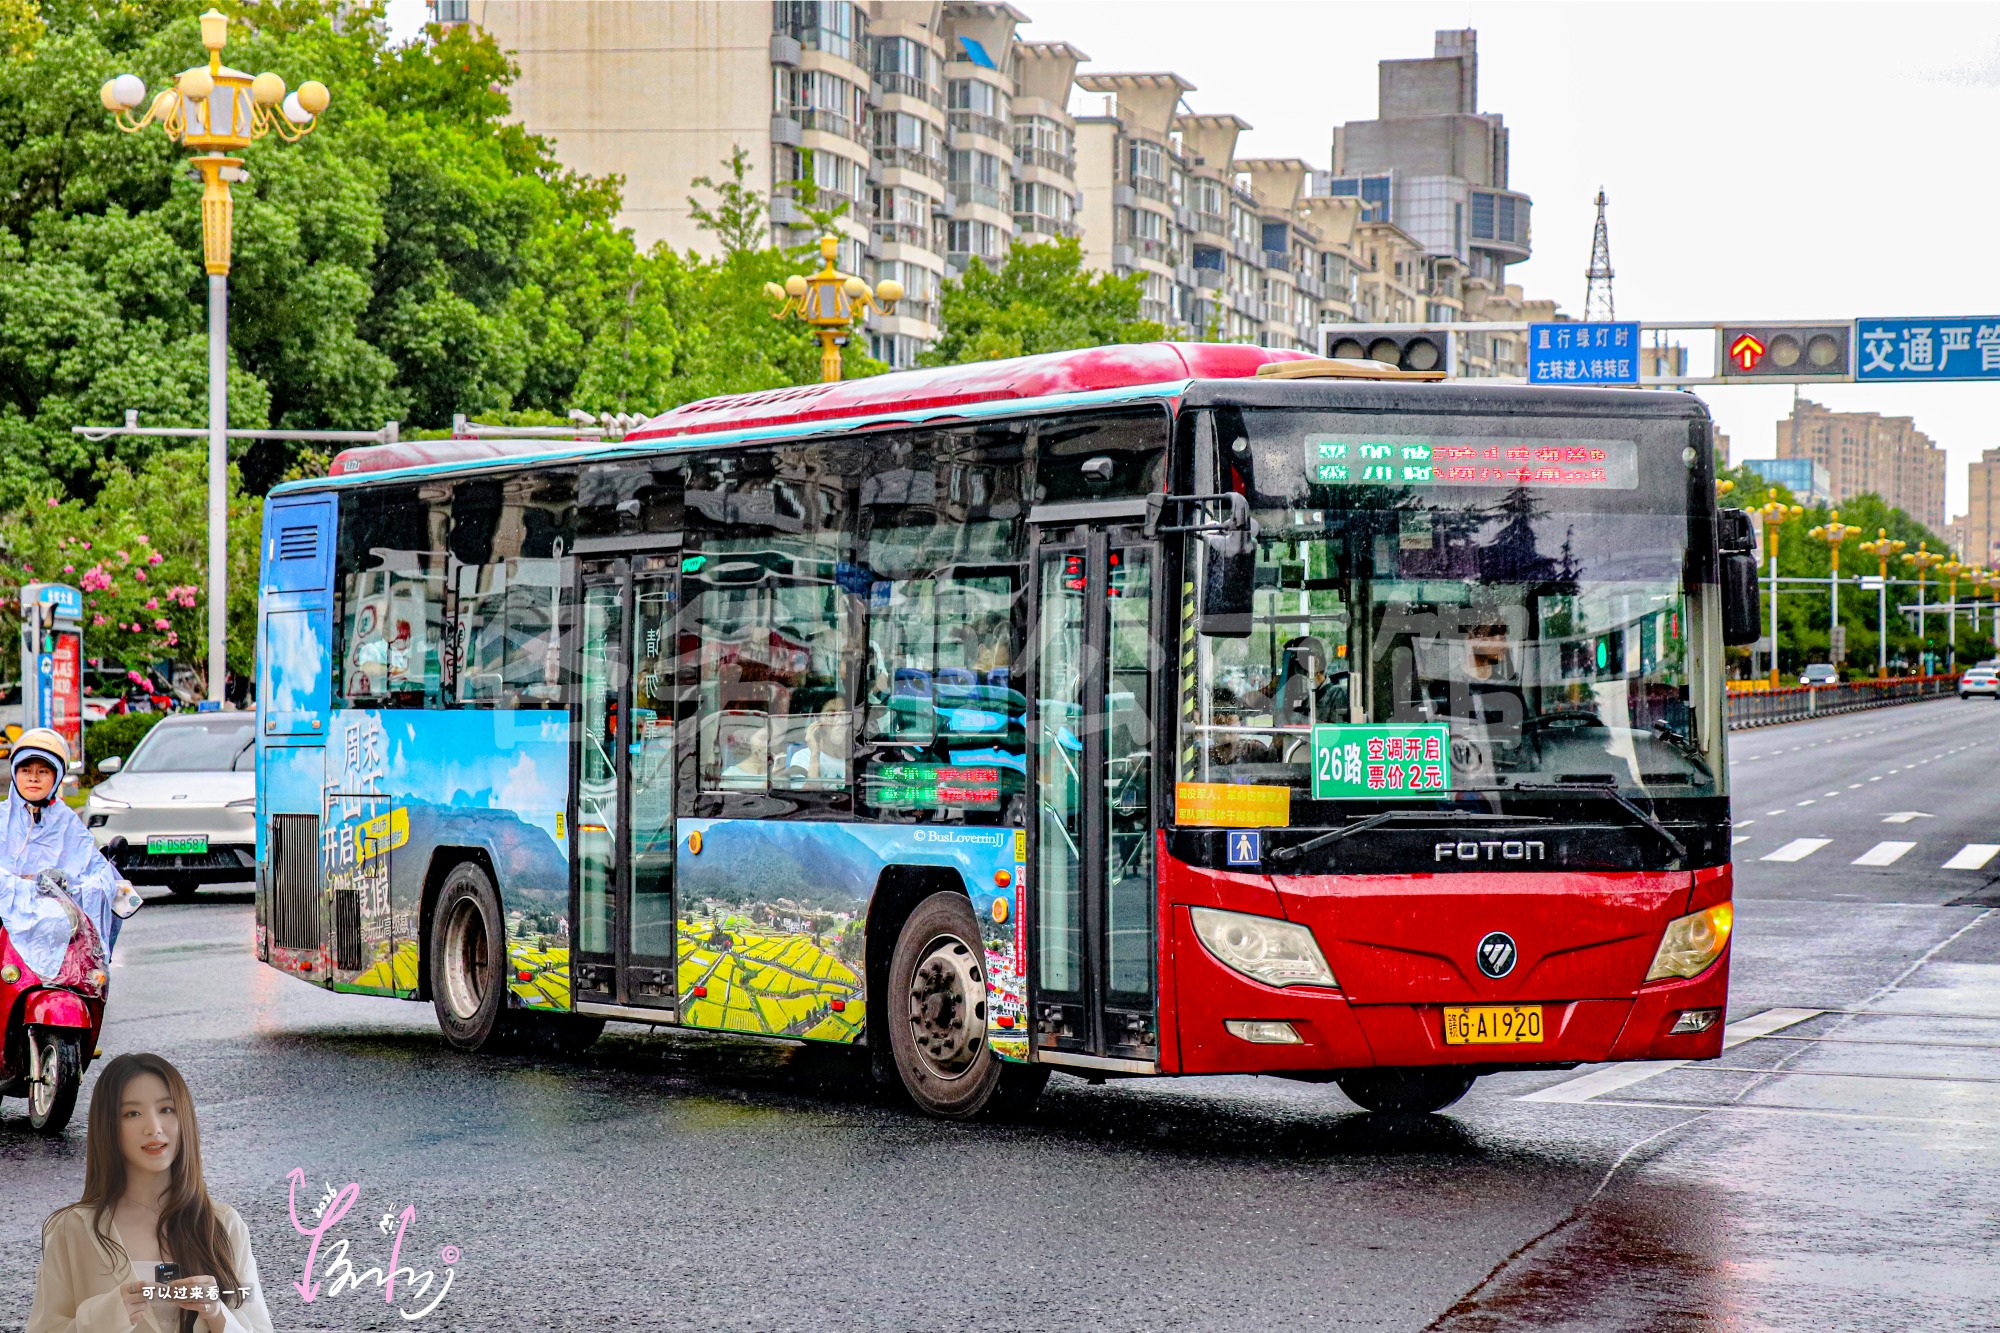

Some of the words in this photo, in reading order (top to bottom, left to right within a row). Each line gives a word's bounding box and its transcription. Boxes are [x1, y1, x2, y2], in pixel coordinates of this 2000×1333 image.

[1538, 327, 1630, 349] 直行绿灯时
[1862, 324, 2000, 373] 交通严管
[1536, 358, 1630, 380] 左转进入待转区
[343, 721, 381, 774] 周末
[1319, 741, 1362, 785] 26路
[1367, 736, 1440, 762] 空调开启
[1367, 764, 1443, 790] 票价2元
[319, 767, 384, 827] 庐山下
[322, 822, 355, 869] 开启
[1434, 840, 1546, 863] FOTON
